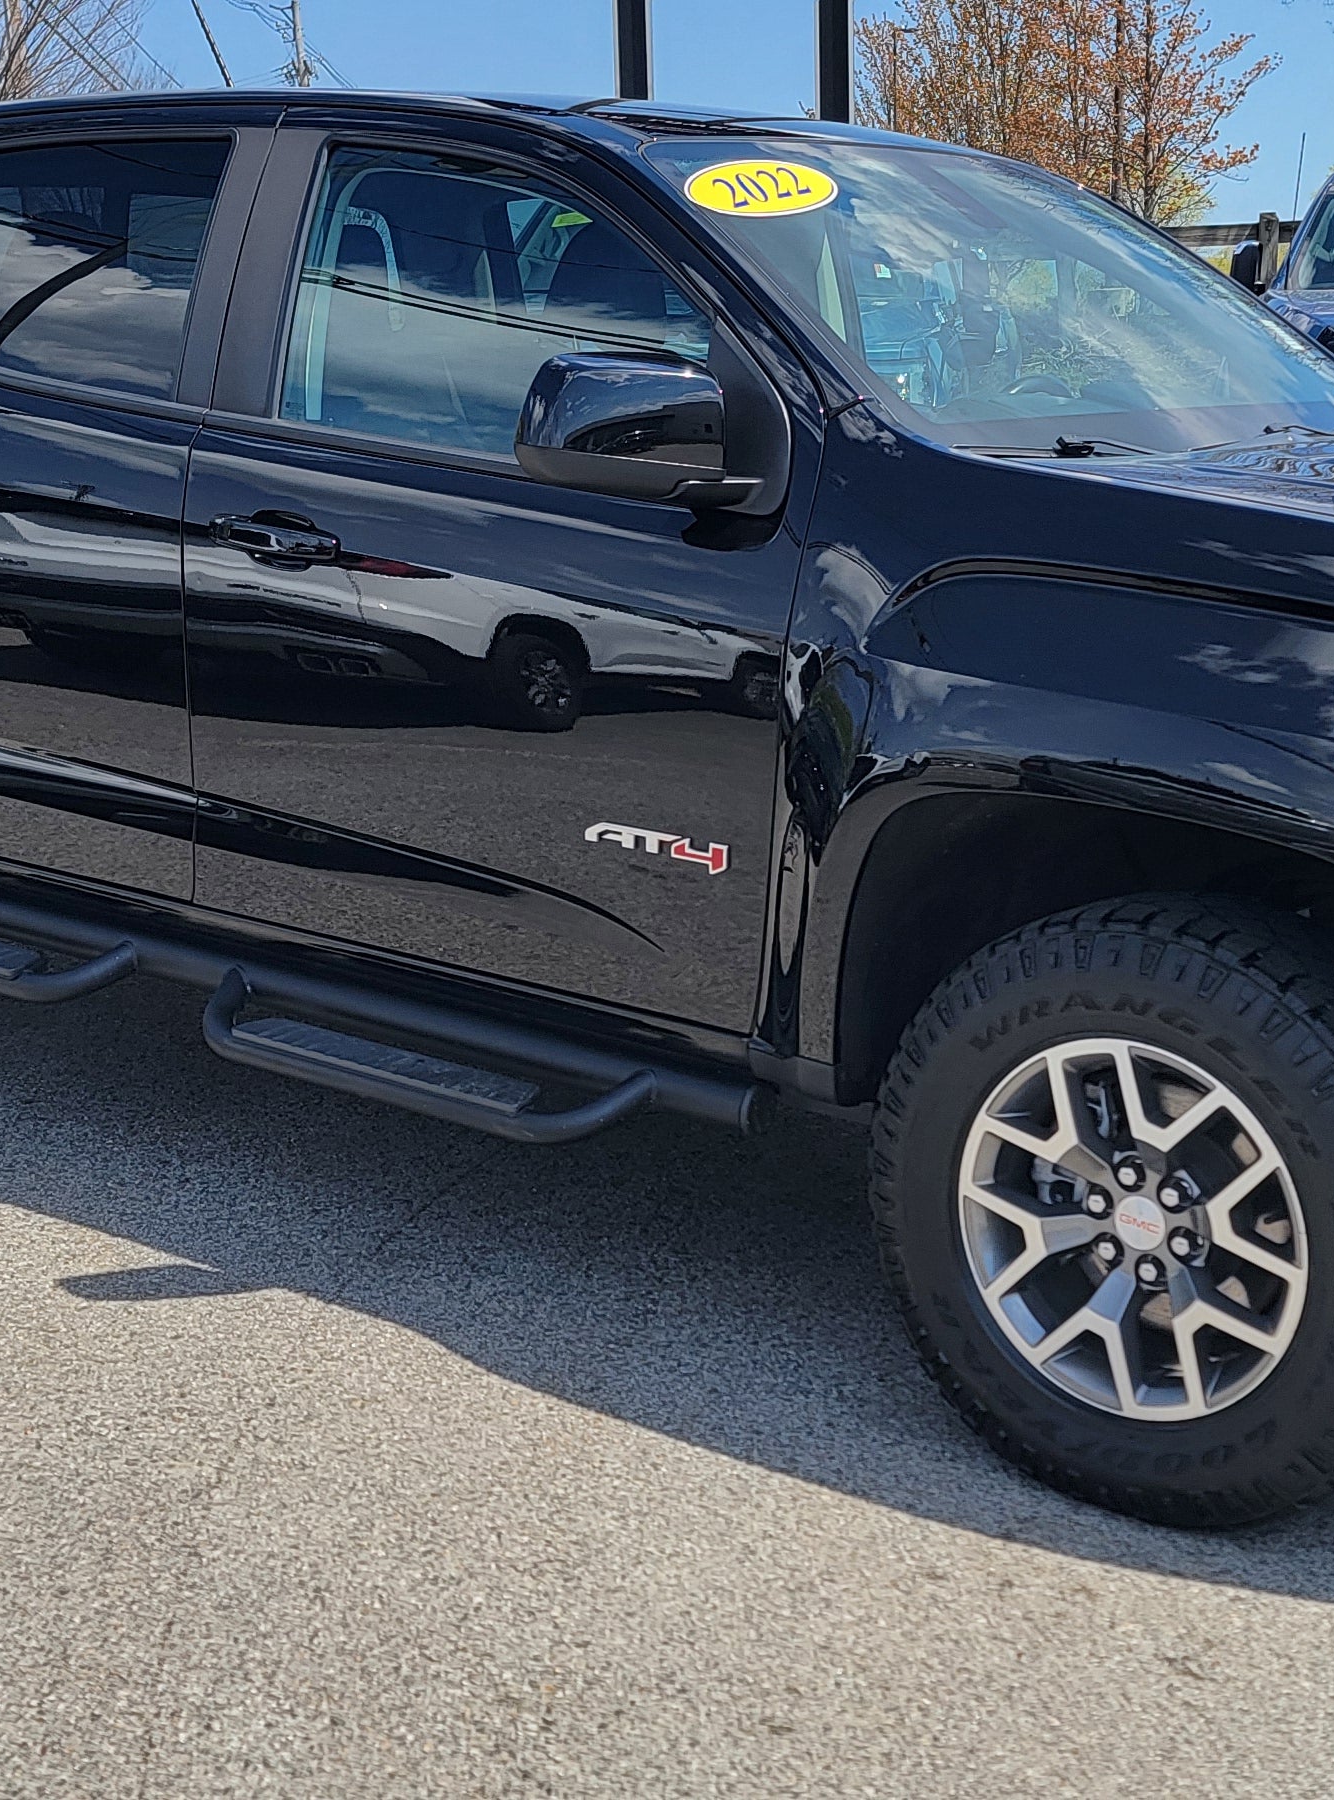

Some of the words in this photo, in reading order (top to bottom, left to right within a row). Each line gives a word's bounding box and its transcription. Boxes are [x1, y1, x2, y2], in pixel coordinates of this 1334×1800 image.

[712, 167, 812, 208] 2022
[584, 821, 730, 875] AT4
[1119, 1213, 1161, 1235] GMC
